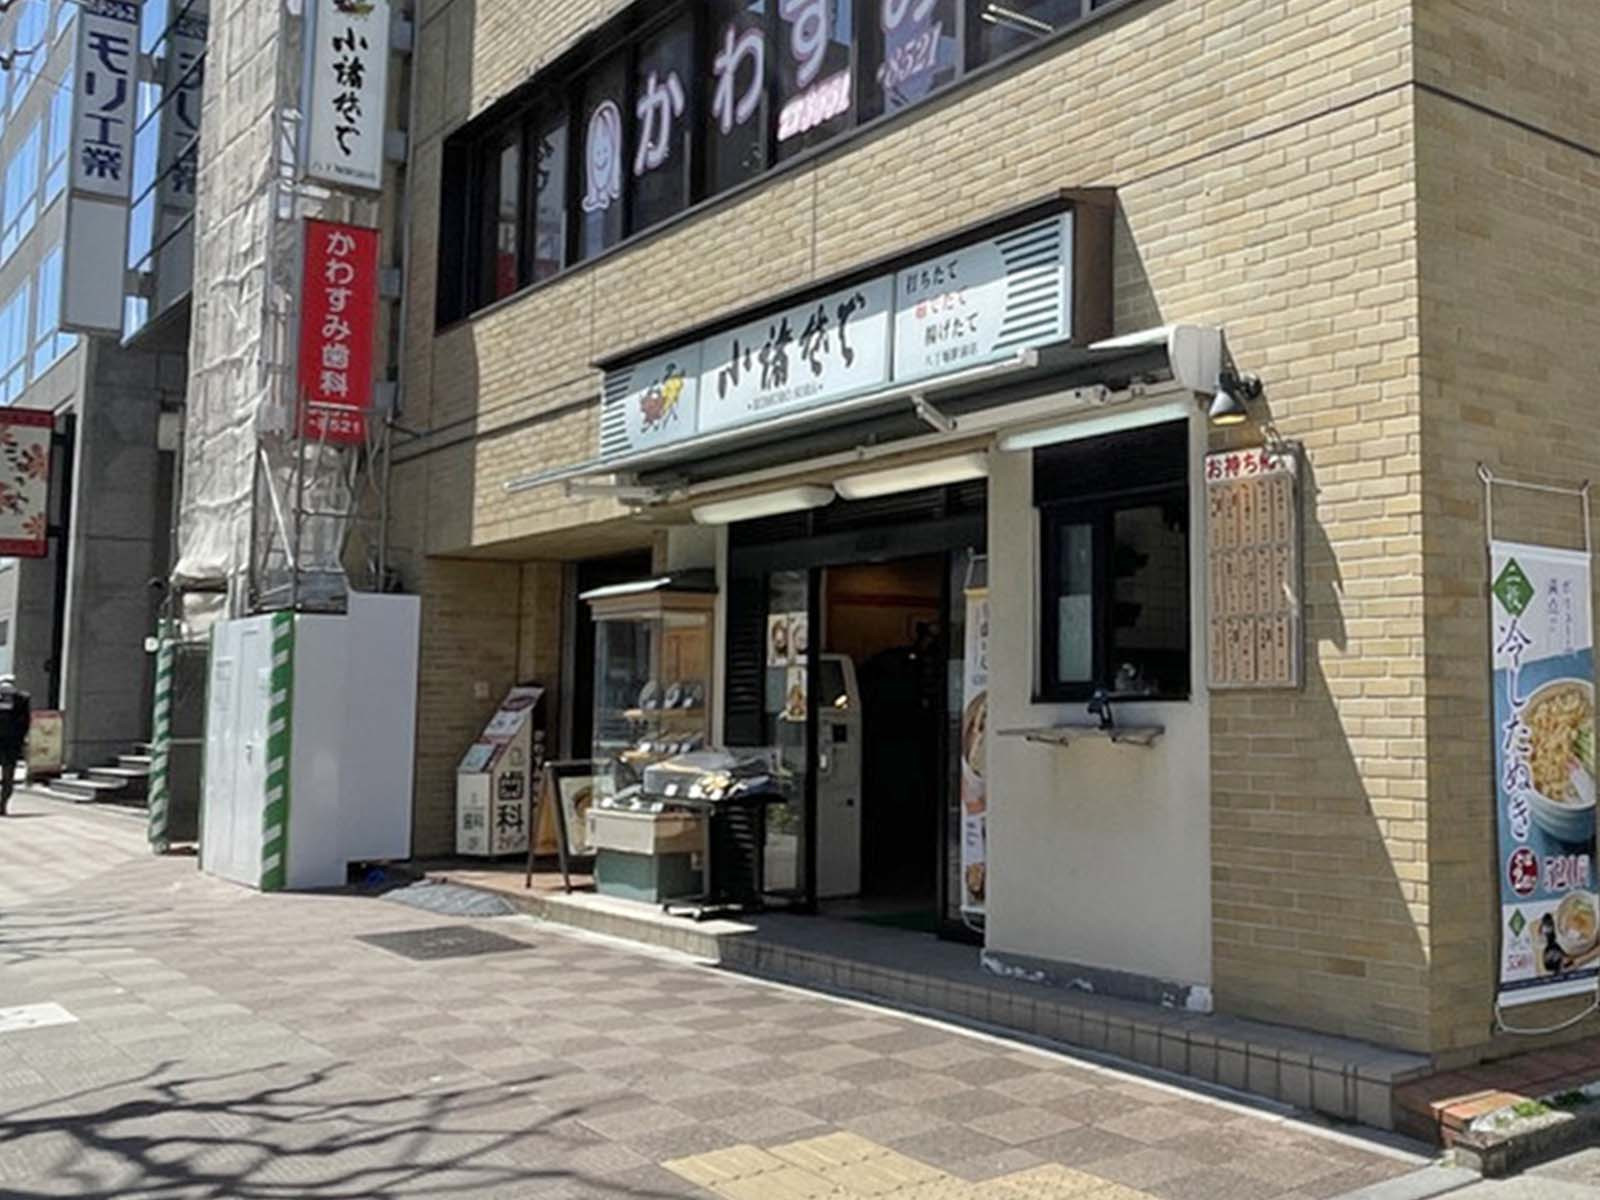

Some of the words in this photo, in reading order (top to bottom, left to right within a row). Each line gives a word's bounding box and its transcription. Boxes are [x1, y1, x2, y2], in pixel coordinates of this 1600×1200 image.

[82, 31, 129, 181] モリ工業
[320, 230, 356, 398] かわすみ歯科
[906, 260, 958, 295] 打ちたて
[497, 770, 525, 835] 歯科
